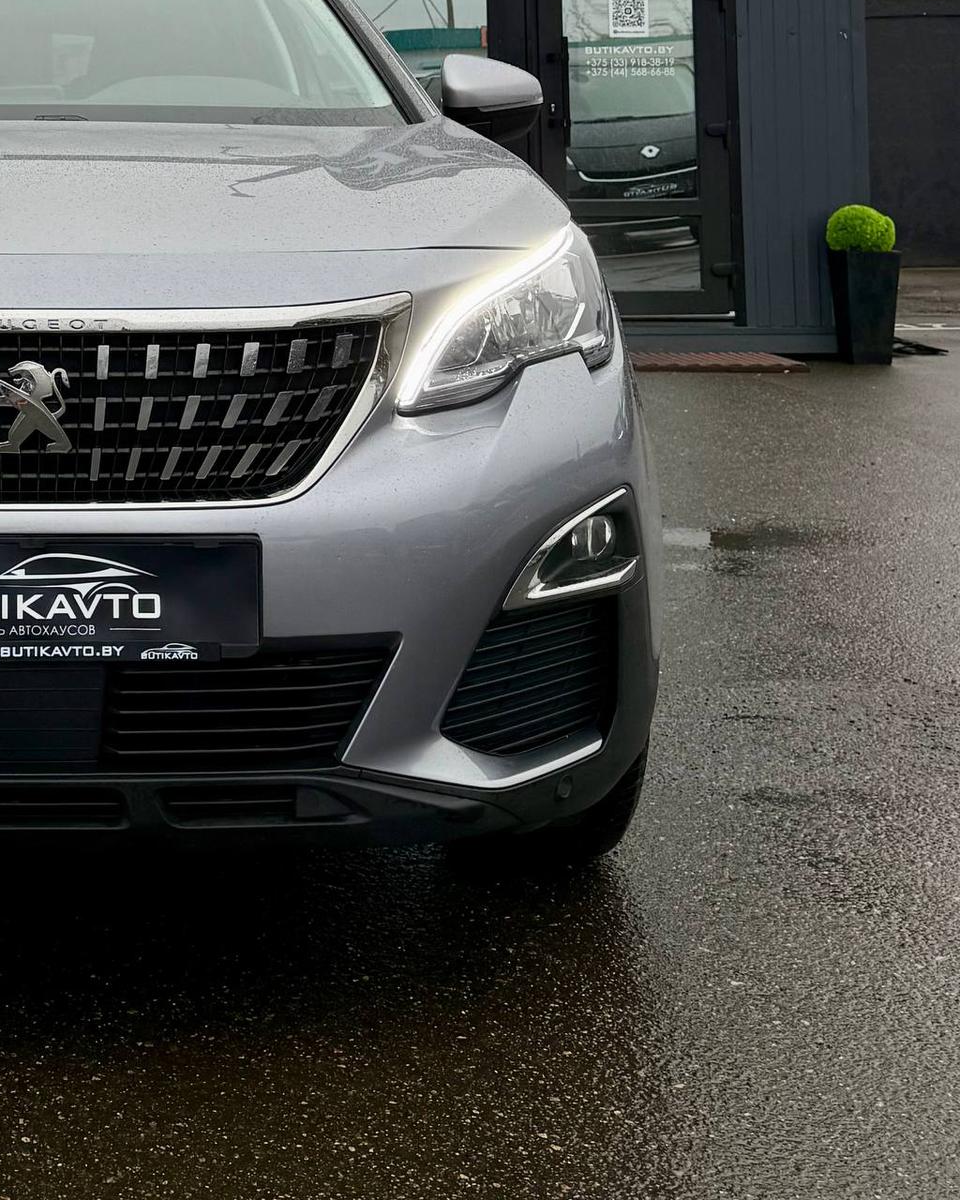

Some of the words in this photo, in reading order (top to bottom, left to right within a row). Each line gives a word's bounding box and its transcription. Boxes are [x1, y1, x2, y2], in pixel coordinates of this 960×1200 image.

[585, 46, 674, 54] BUTIKAVTO.BY
[610, 58, 627, 68] (33)
[610, 68, 627, 78] (44)
[9, 624, 96, 637] АВТОХАУСОВ
[0, 645, 124, 658] BUTIKAVTO.BY
[140, 650, 198, 661] BUTIKAVTO
